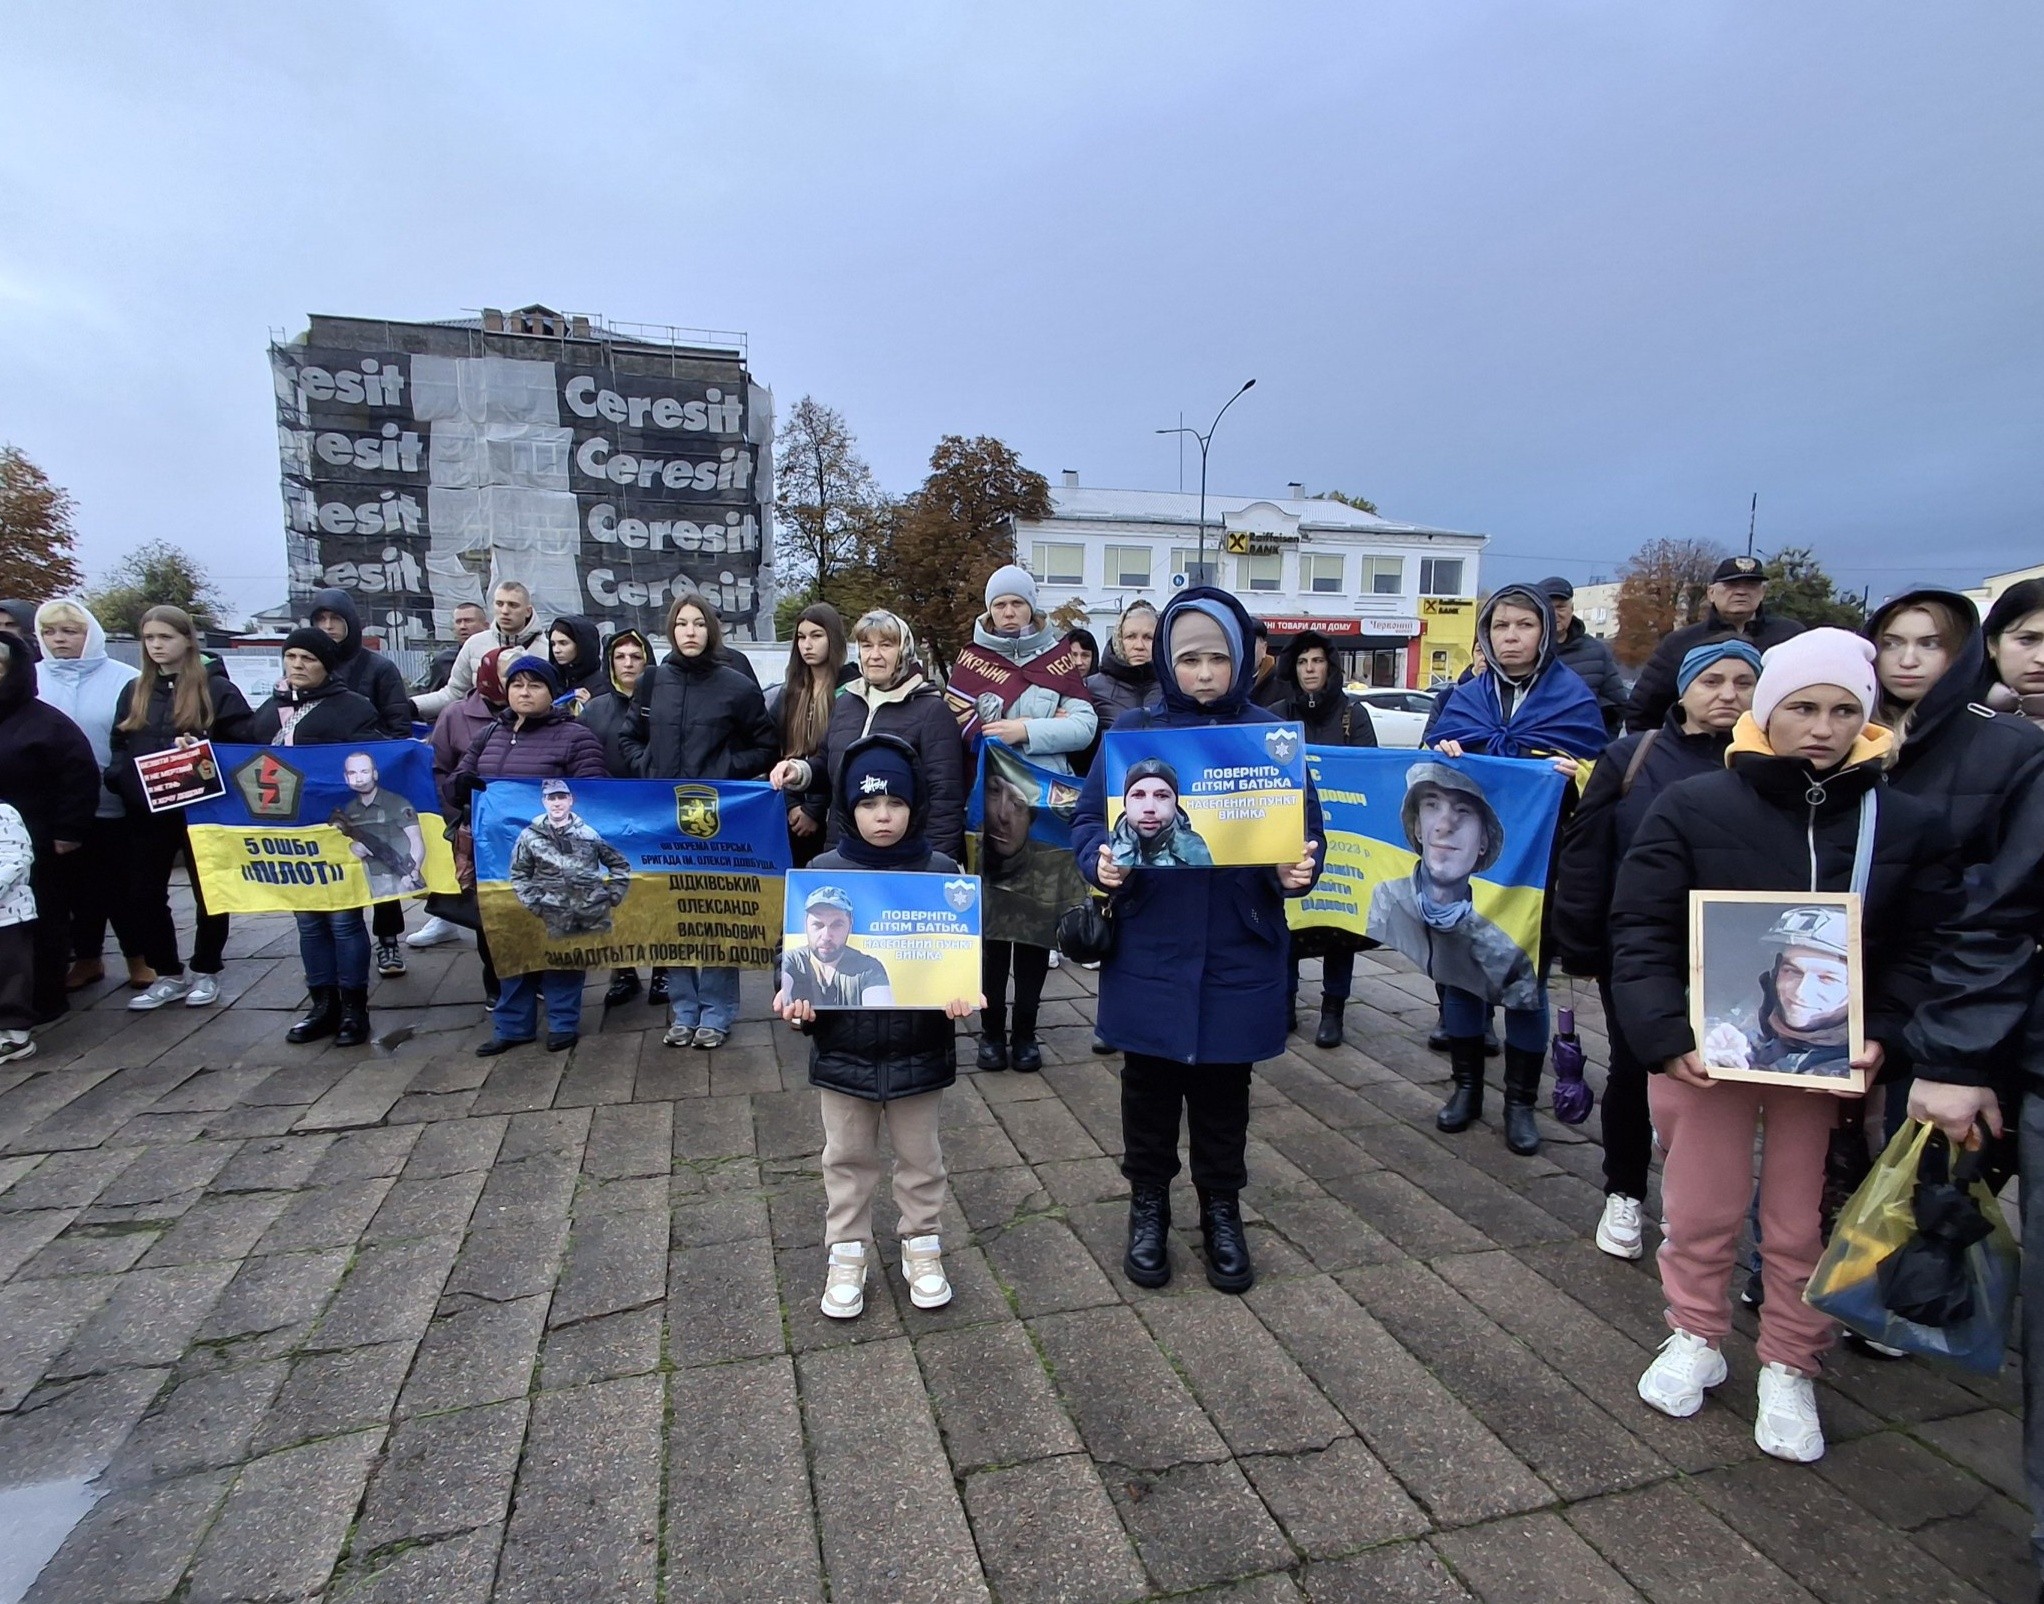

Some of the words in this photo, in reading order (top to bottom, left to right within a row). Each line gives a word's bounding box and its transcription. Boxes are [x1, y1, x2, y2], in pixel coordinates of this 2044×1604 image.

[565, 375, 743, 433] Ceresit
[576, 436, 754, 491] Ceresit
[587, 502, 759, 554] Ceresit
[1249, 532, 1300, 543] Raiffeisen
[1249, 544, 1280, 555] BANK
[586, 568, 754, 612] Ceresit
[1277, 622, 1309, 630] ТОВАРИ
[1310, 622, 1326, 631] ДЛЯ
[1328, 623, 1351, 632] ДОМУ
[1203, 765, 1280, 780] ПОВЕРНІТЬ
[1191, 780, 1235, 792] ДІТЯМ
[1238, 777, 1292, 791] БАТЬКА
[1259, 795, 1299, 806] ПУНКТ
[243, 837, 260, 855] 5
[261, 837, 320, 857] ОШБр
[674, 842, 709, 851] ОКРЕМА
[641, 854, 682, 865] БРИГАДА
[697, 855, 732, 866] ОЛЕКСИ
[669, 874, 761, 893] ДІДКІВСЬКИЙ
[677, 898, 760, 916] ОЛЕКСАНДР
[881, 909, 957, 921] ПОВЕРНІТЬ
[677, 921, 766, 942] ВАСИЛЬОВИЧ
[869, 921, 912, 932] ДІТЯМ
[915, 922, 969, 933] БАТЬКА
[626, 944, 646, 961] ТА
[648, 943, 725, 961] ПОВЕРНІТЬ
[936, 940, 973, 950] ПУНКТ
